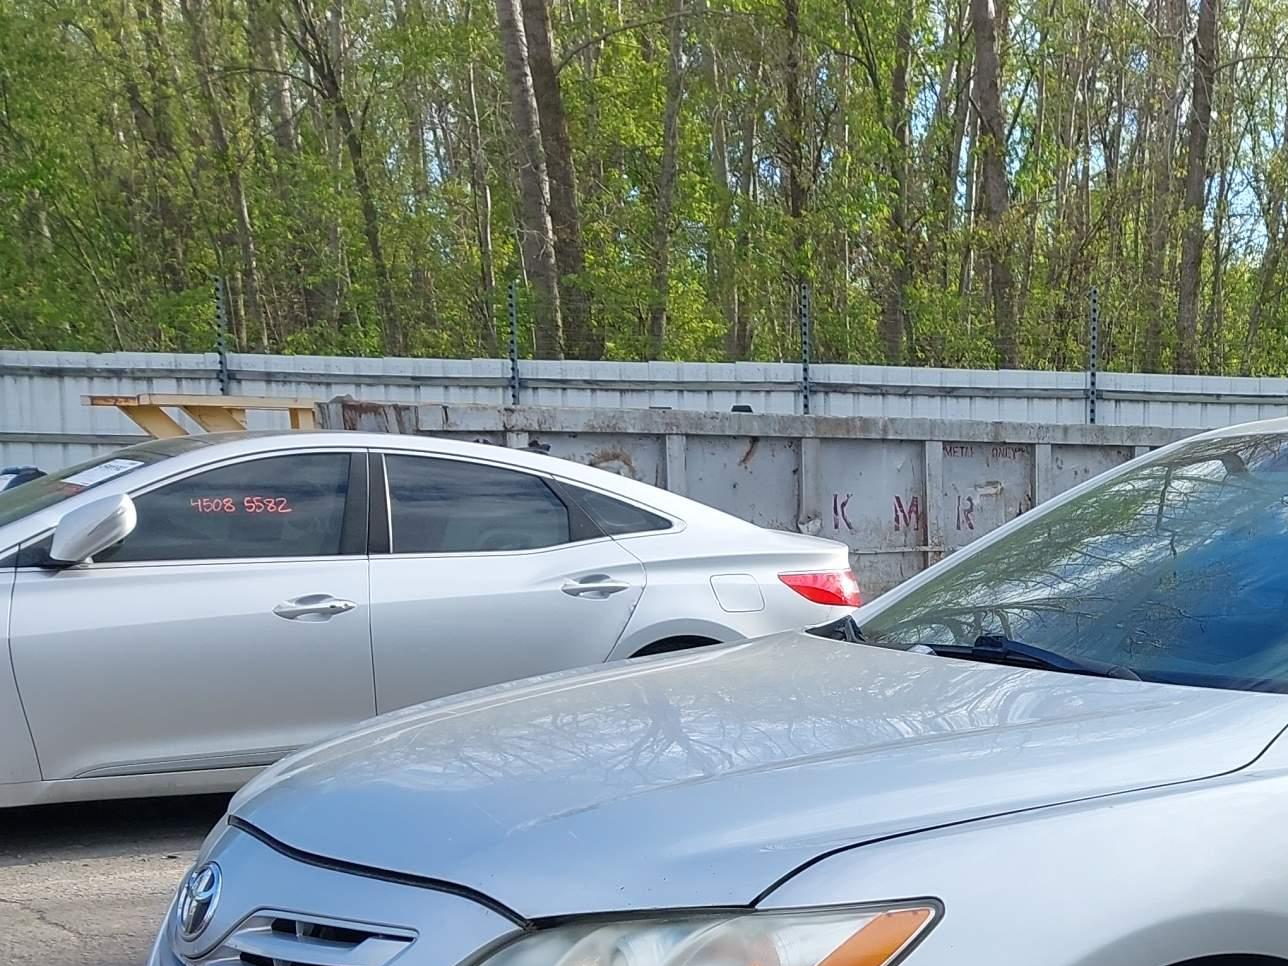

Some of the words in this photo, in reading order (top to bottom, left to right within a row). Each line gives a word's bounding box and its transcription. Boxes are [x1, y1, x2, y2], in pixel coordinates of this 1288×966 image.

[190, 497, 236, 513] 4508
[243, 496, 293, 513] 5582
[832, 493, 854, 531] K
[893, 494, 920, 532] M
[955, 495, 975, 531] R
